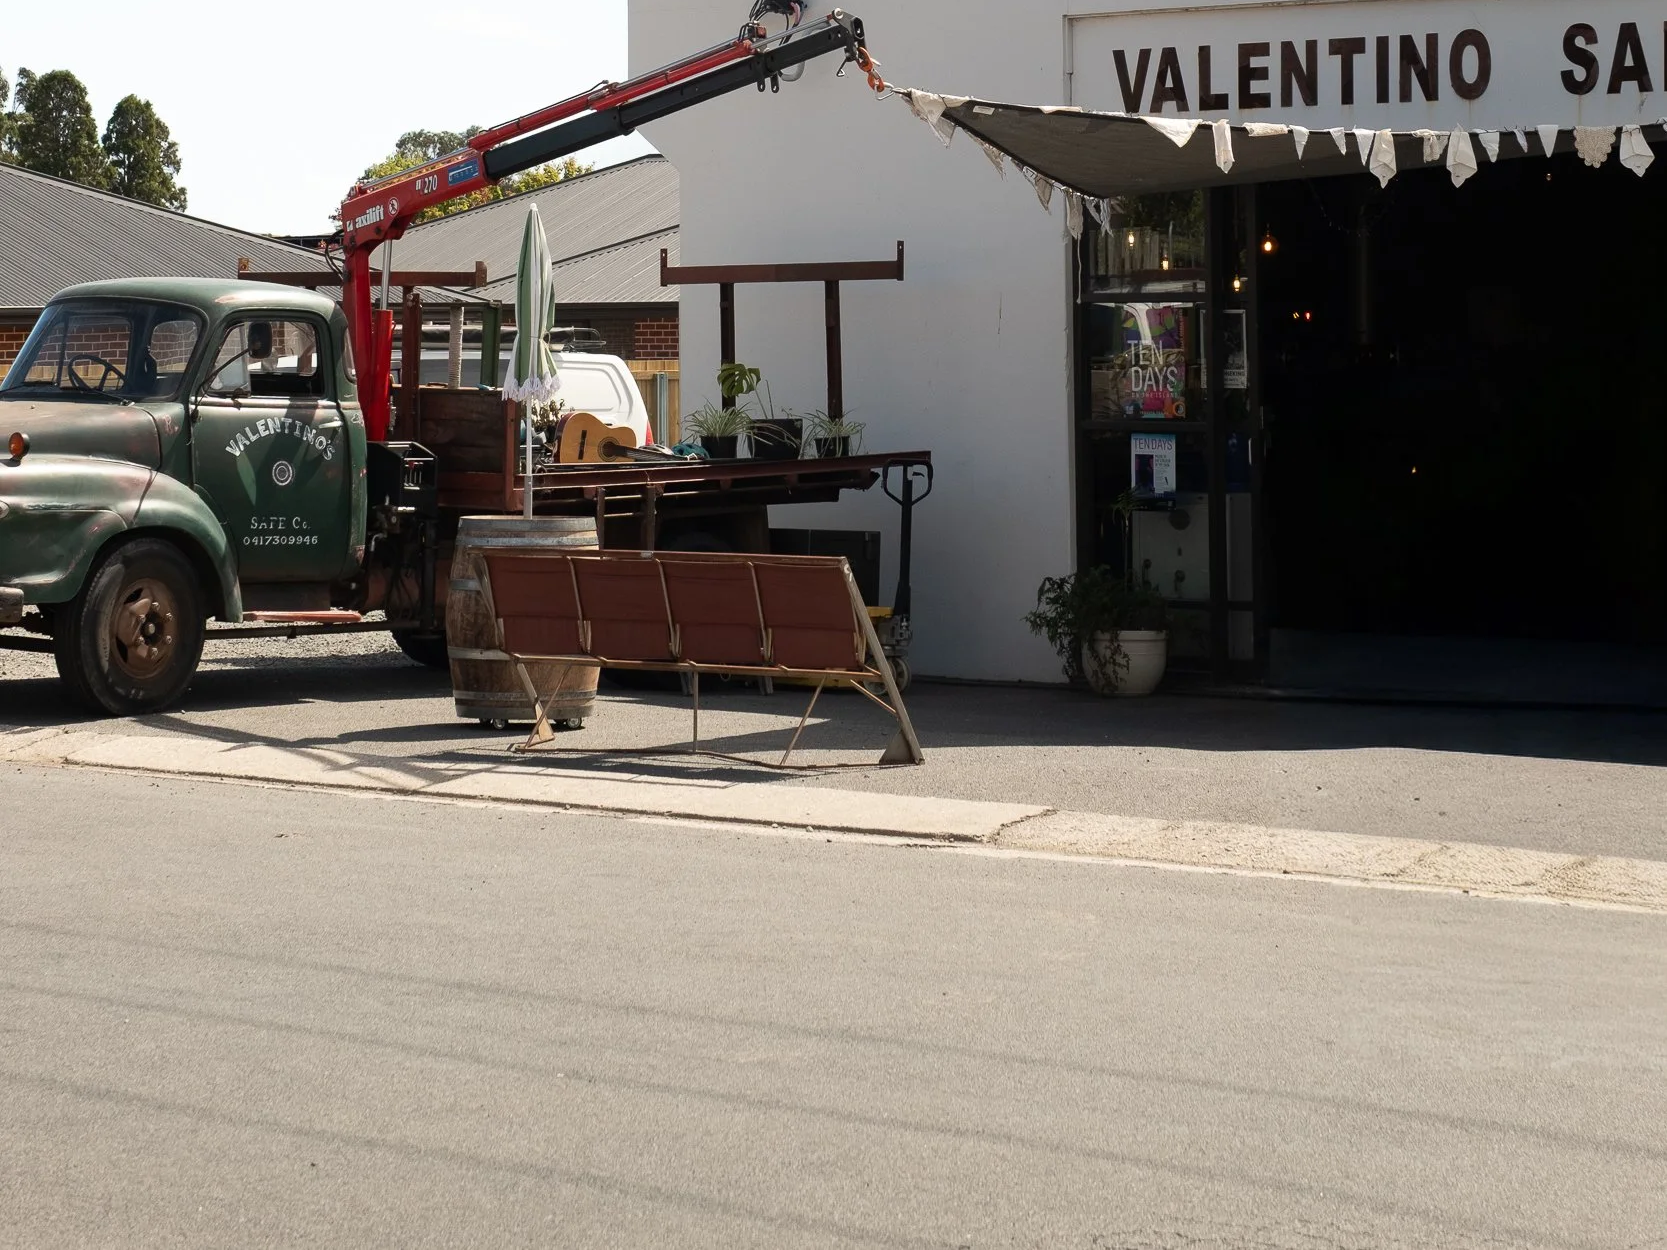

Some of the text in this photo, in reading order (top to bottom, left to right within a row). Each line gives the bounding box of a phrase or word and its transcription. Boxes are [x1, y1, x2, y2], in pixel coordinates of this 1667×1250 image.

[1112, 20, 1667, 114] VALENTINO SA
[1126, 339, 1163, 366] TEN
[1131, 366, 1178, 392] DAYS
[225, 417, 335, 461] VALENTINO'S
[1133, 438, 1173, 451] TEN DAYS
[250, 516, 286, 530] SAFE
[243, 535, 318, 546] 0417309946
